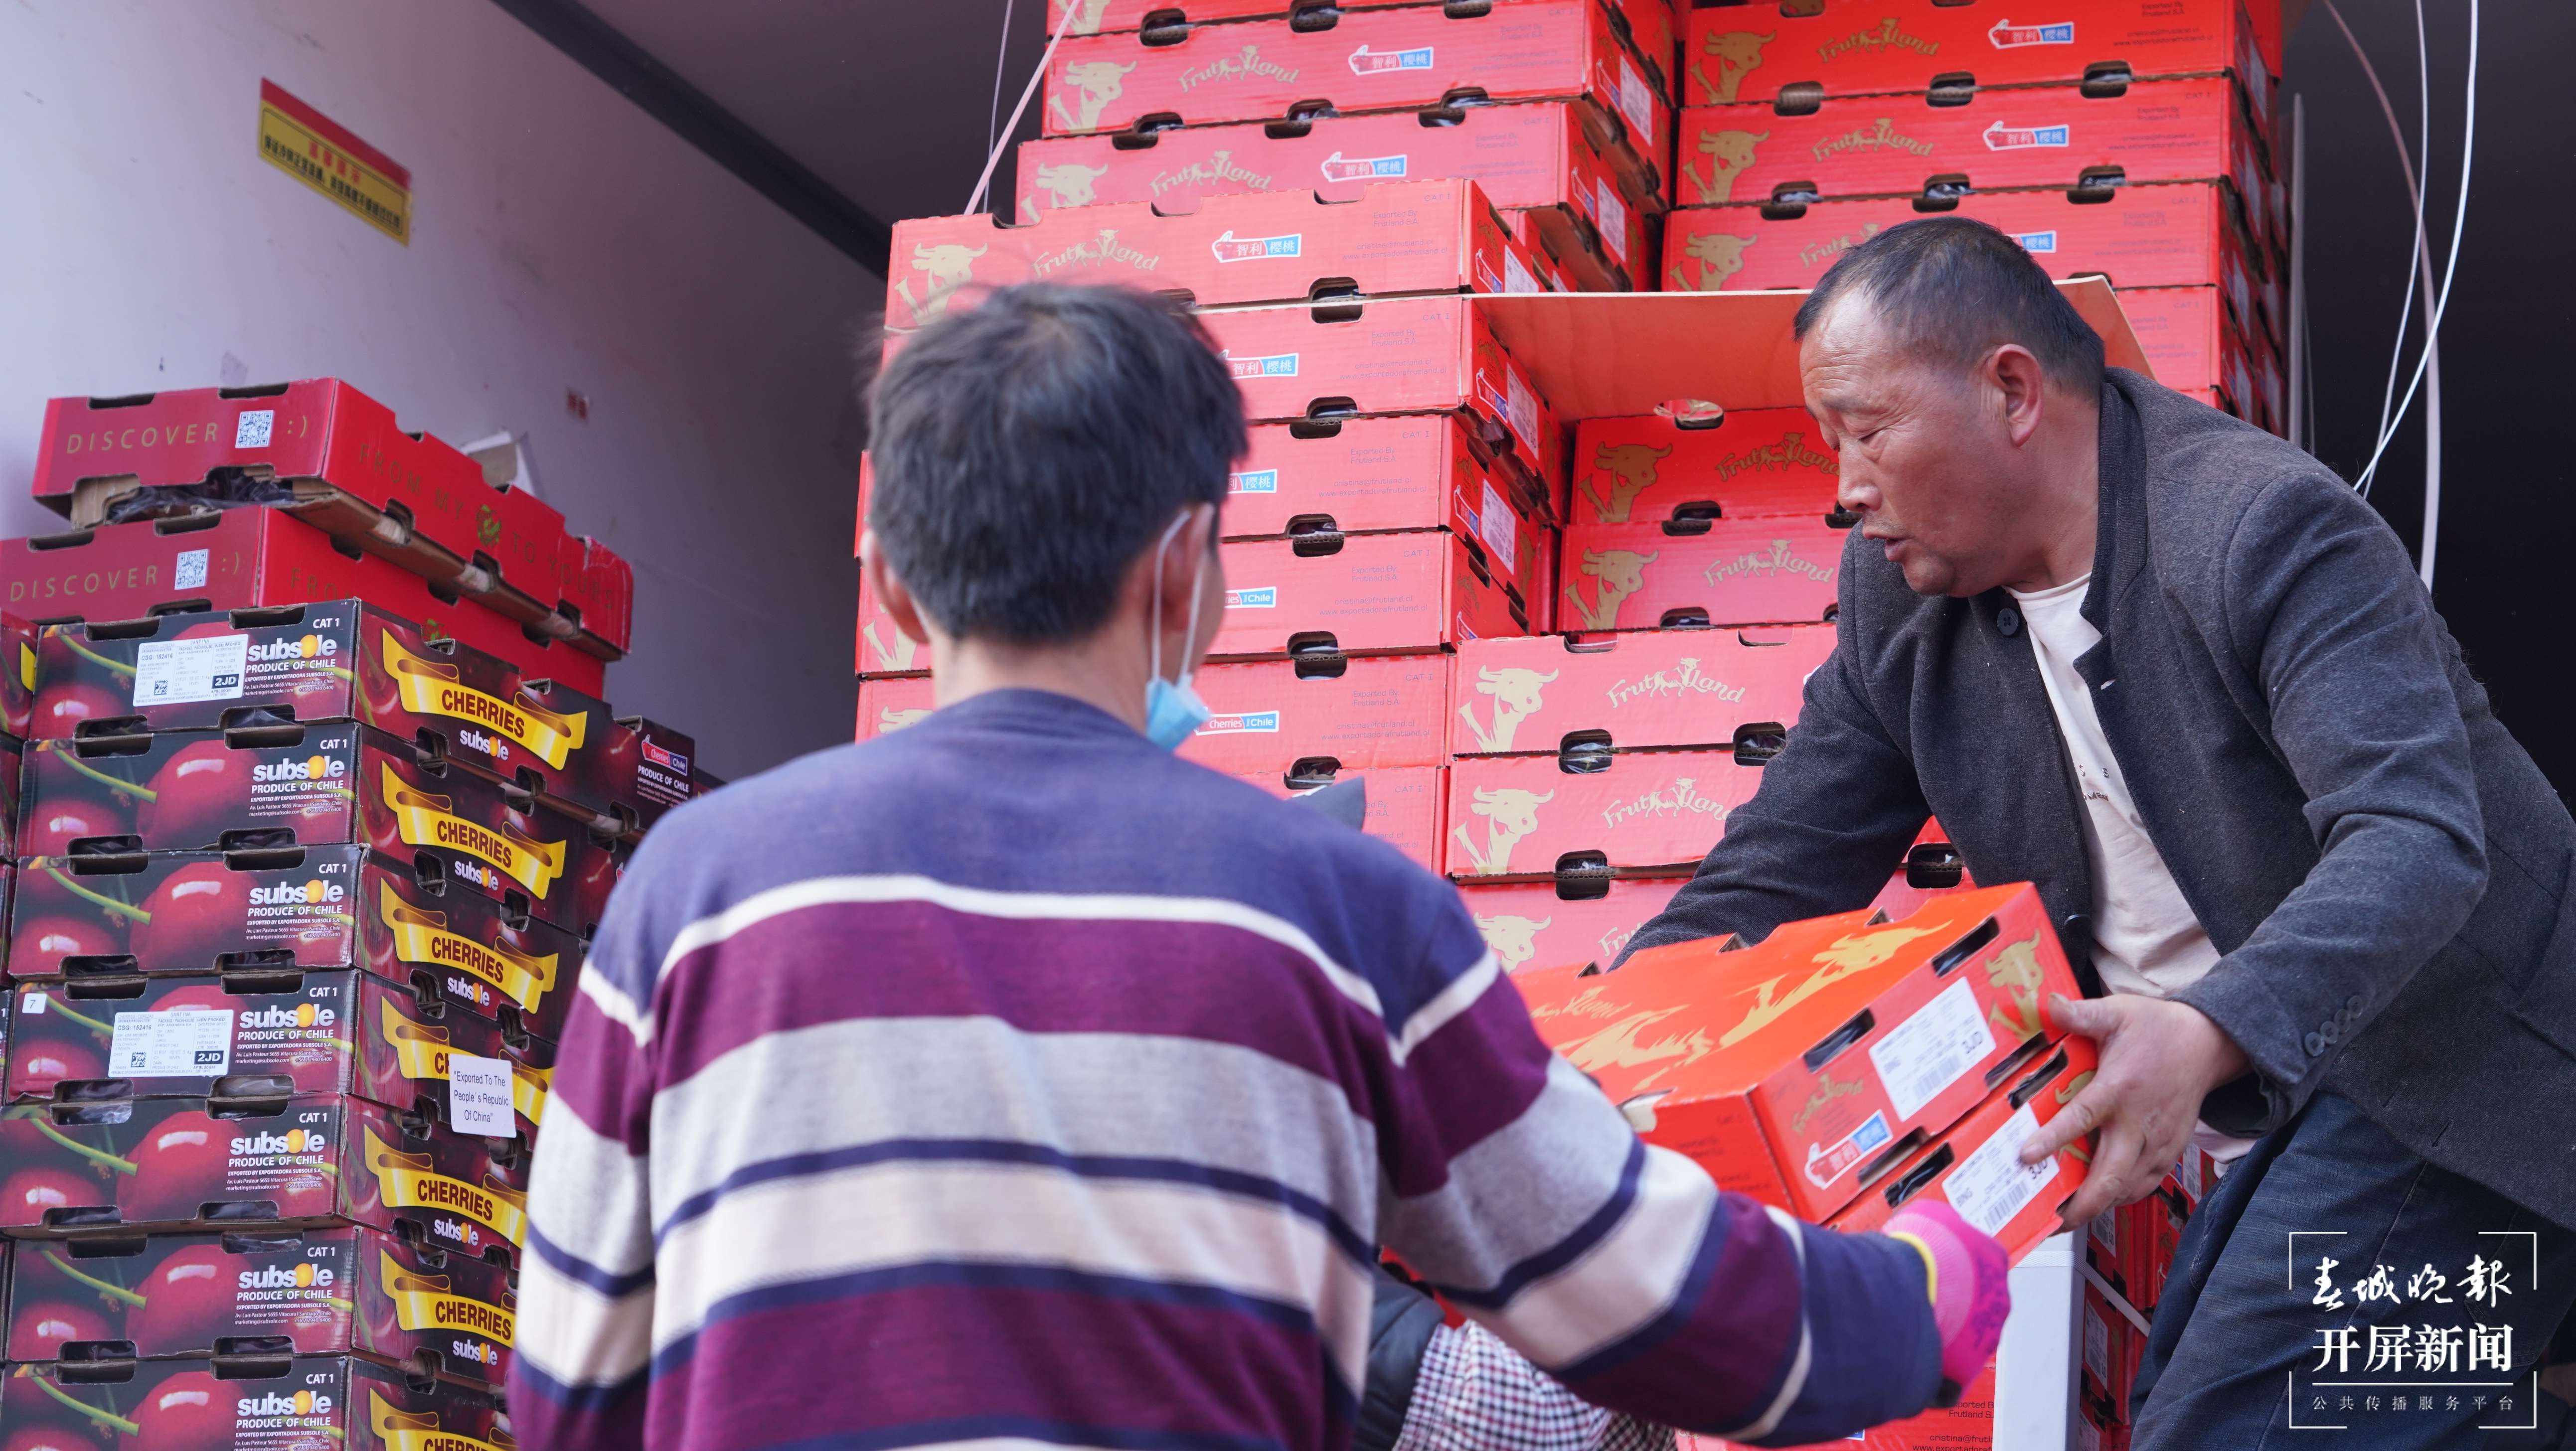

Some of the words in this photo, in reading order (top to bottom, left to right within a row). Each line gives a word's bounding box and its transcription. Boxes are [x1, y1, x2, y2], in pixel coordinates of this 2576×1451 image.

[66, 423, 218, 454] DISCOVER
[359, 443, 421, 498] FROM
[435, 486, 464, 521] MY
[512, 531, 537, 564] TO
[549, 558, 614, 610] YOURS
[1351, 566, 1385, 575] Exported
[10, 566, 158, 602] DISCOVER
[1248, 594, 1270, 602] Chile
[313, 618, 332, 628] CAT
[335, 618, 339, 627] 1
[245, 662, 289, 673] PRODUCE
[293, 661, 306, 670] OF
[310, 659, 335, 669] CHILE
[215, 676, 236, 686] 2JD
[1353, 690, 1386, 699] Exported
[442, 689, 526, 739] CHERRIES
[1210, 719, 1242, 728] Cherries
[1250, 718, 1274, 727] Chile
[320, 739, 340, 749] CAT
[343, 739, 347, 748] 1
[651, 748, 669, 764] Cherries
[673, 757, 685, 770] Chile
[638, 765, 663, 783] PRODUCE
[664, 775, 673, 786] OF
[674, 779, 689, 793] CHILE
[251, 783, 296, 794] PRODUCE
[300, 782, 313, 791] OF
[317, 780, 343, 790] CHILE
[437, 820, 512, 869] CHERRIES
[319, 864, 339, 873] CAT
[342, 864, 346, 873] 1
[248, 907, 294, 916] PRODUCE
[298, 906, 311, 915] OF
[315, 905, 342, 914] CHILE
[432, 937, 504, 984] CHERRIES
[310, 988, 330, 997] CAT
[333, 988, 337, 997] 1
[29, 1000, 35, 1009] 7
[238, 1031, 284, 1040] PRODUCE
[289, 1030, 302, 1039] OF
[306, 1029, 334, 1039] CHILE
[197, 1052, 221, 1062] 2JD
[484, 1075, 493, 1086] To
[493, 1075, 505, 1087] The
[483, 1095, 509, 1106] Republic
[300, 1113, 320, 1123] CAT
[322, 1113, 327, 1122] 1
[464, 1109, 472, 1121] Of
[473, 1110, 493, 1123] China"
[229, 1157, 275, 1167] PRODUCE
[279, 1157, 292, 1165] OF
[296, 1155, 323, 1164] CHILE
[417, 1179, 493, 1222] CHERRIES
[308, 1247, 328, 1257] CAT
[331, 1247, 335, 1256] 1
[237, 1291, 283, 1301] PRODUCE
[287, 1291, 300, 1300] OF
[304, 1290, 332, 1299] CHILE
[435, 1301, 512, 1340] CHERRIES
[306, 1374, 326, 1384] CAT
[329, 1374, 333, 1383] 1
[1948, 1410, 1983, 1418] Frutland
[236, 1419, 282, 1428] PRODUCE
[286, 1418, 300, 1427] OF
[304, 1417, 331, 1427] CHILE
